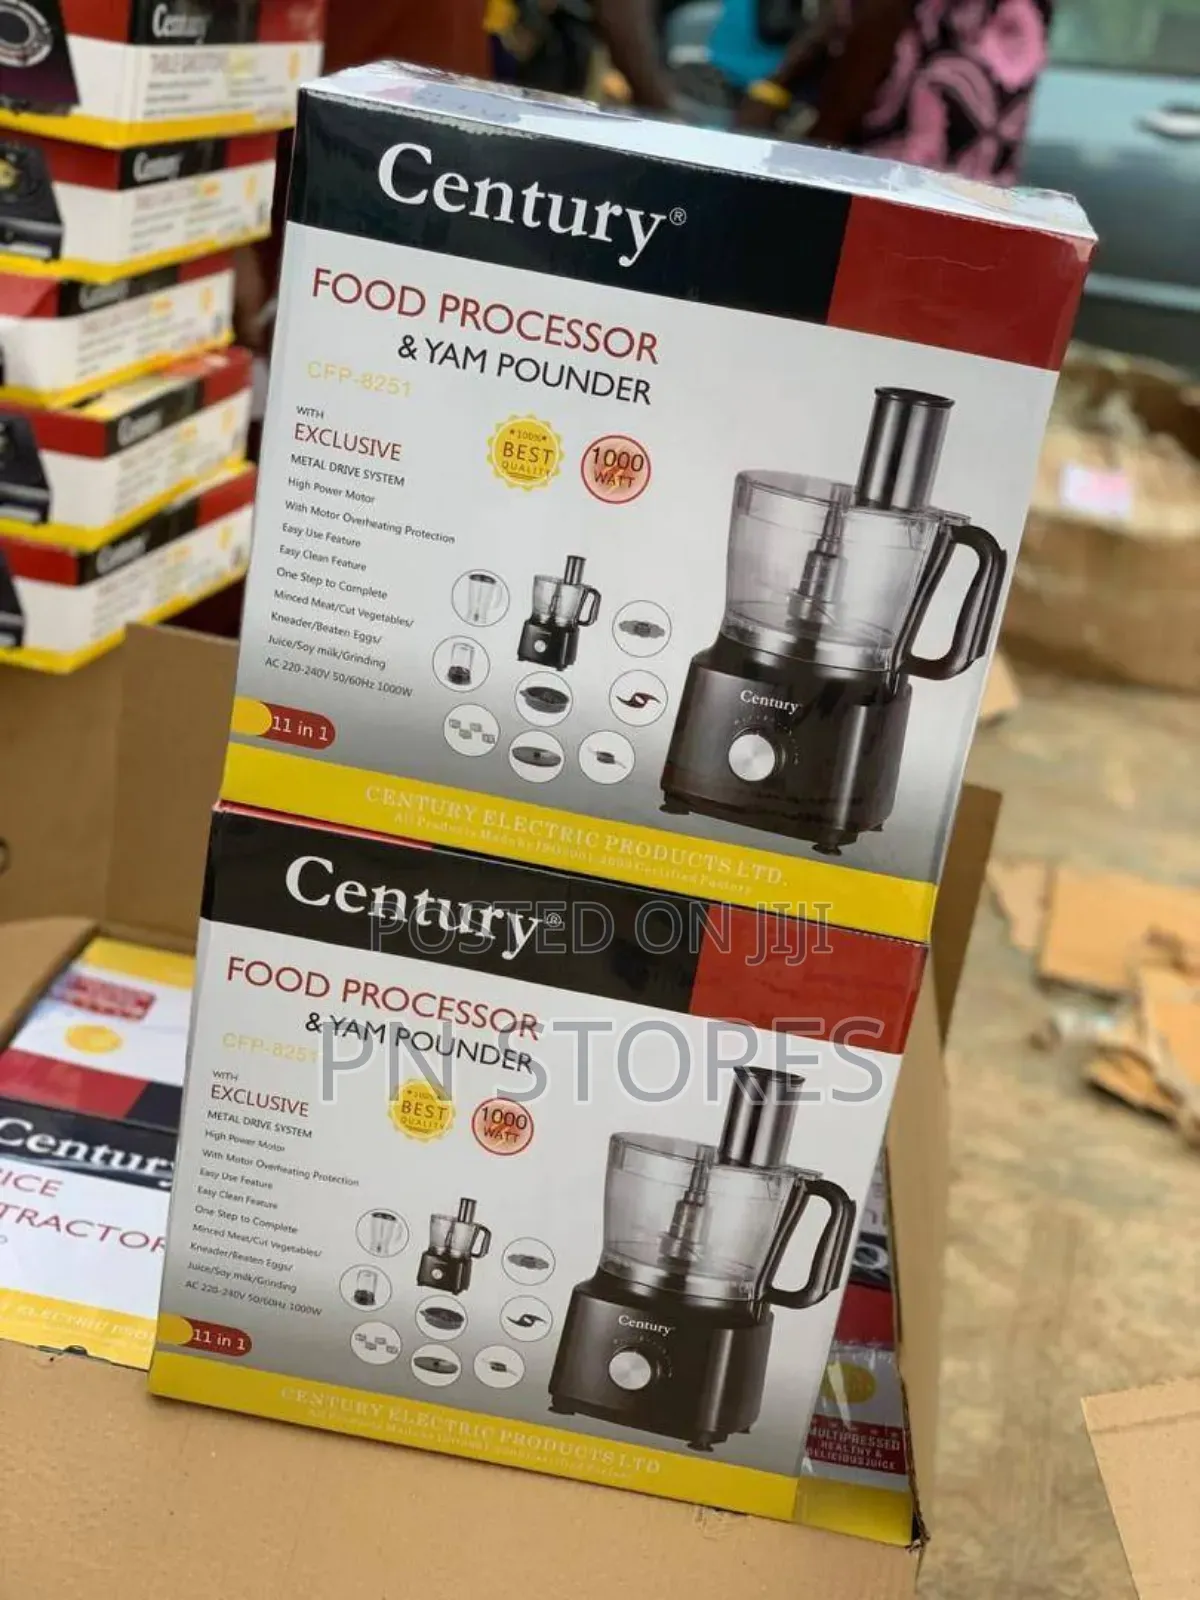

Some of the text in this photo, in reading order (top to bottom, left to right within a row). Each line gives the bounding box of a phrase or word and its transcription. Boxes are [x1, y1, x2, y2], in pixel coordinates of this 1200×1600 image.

[312, 268, 660, 365] FOOD PROCESSOR
[306, 360, 412, 397] CFP-8251
[397, 334, 652, 406] & YAM POUNDER
[296, 405, 324, 420] WITH
[294, 423, 403, 462] EXCLUSIVE
[502, 440, 554, 465] BEST
[290, 454, 406, 488] METAL DRIVE SYSTEM
[501, 460, 551, 478] QUALITY
[592, 446, 645, 473] 1000
[287, 477, 376, 504] High Power Motor
[593, 466, 636, 489] WATT
[281, 523, 362, 548] Easy Use Feature
[284, 500, 456, 544] With Motor Overheating Protection
[279, 545, 367, 572] Easy Clean Feature
[276, 566, 389, 601] One Step to Complete
[273, 589, 415, 629] Minced Meat/Cut Vegetables/
[270, 611, 383, 646] Kneader/Beaten Eggs/
[267, 634, 387, 671] Juice/Soy milk/Grinding
[264, 656, 413, 698] AC 220-240V 50/60Hz 1000W
[739, 689, 800, 715] Century
[272, 715, 329, 742] 11 in 1
[364, 784, 479, 823] CENTURY
[482, 808, 600, 849] ELECTRIC
[604, 834, 732, 874] PRODUCTS
[226, 956, 540, 1041] FOOD PROCESSOR
[222, 1032, 319, 1064] CFP-8251
[304, 1012, 533, 1075] & YAM POUNDER
[212, 1069, 239, 1082] WITH
[210, 1084, 310, 1118] EXCLUSIVE
[400, 1099, 449, 1121] BEST
[206, 1110, 313, 1139] METAL DRIVE SYSTEM
[400, 1115, 445, 1131] QUALITY
[481, 1106, 528, 1130] 1000
[204, 1129, 286, 1153] High Power Motor
[483, 1126, 531, 1144] WATT
[199, 1168, 274, 1190] Easy Use Feature
[201, 1148, 360, 1188] With Motor Overheating Protection
[197, 1186, 279, 1210] Easy Clean Feature
[194, 1204, 299, 1236] One Step to Complete
[192, 1223, 323, 1259] Minced Meat/Cut Vegetables/
[189, 1242, 294, 1273] Kneader/Beaten Eggs/
[187, 1261, 298, 1295] Juice/Soy milk/Grinding
[185, 1281, 200, 1290] AC
[289, 1303, 323, 1317] 1000W
[192, 1328, 246, 1351] 11 in 1
[618, 1314, 672, 1337] Century
[281, 1386, 383, 1419] CENTURY
[388, 1406, 494, 1440] ELECTRIC
